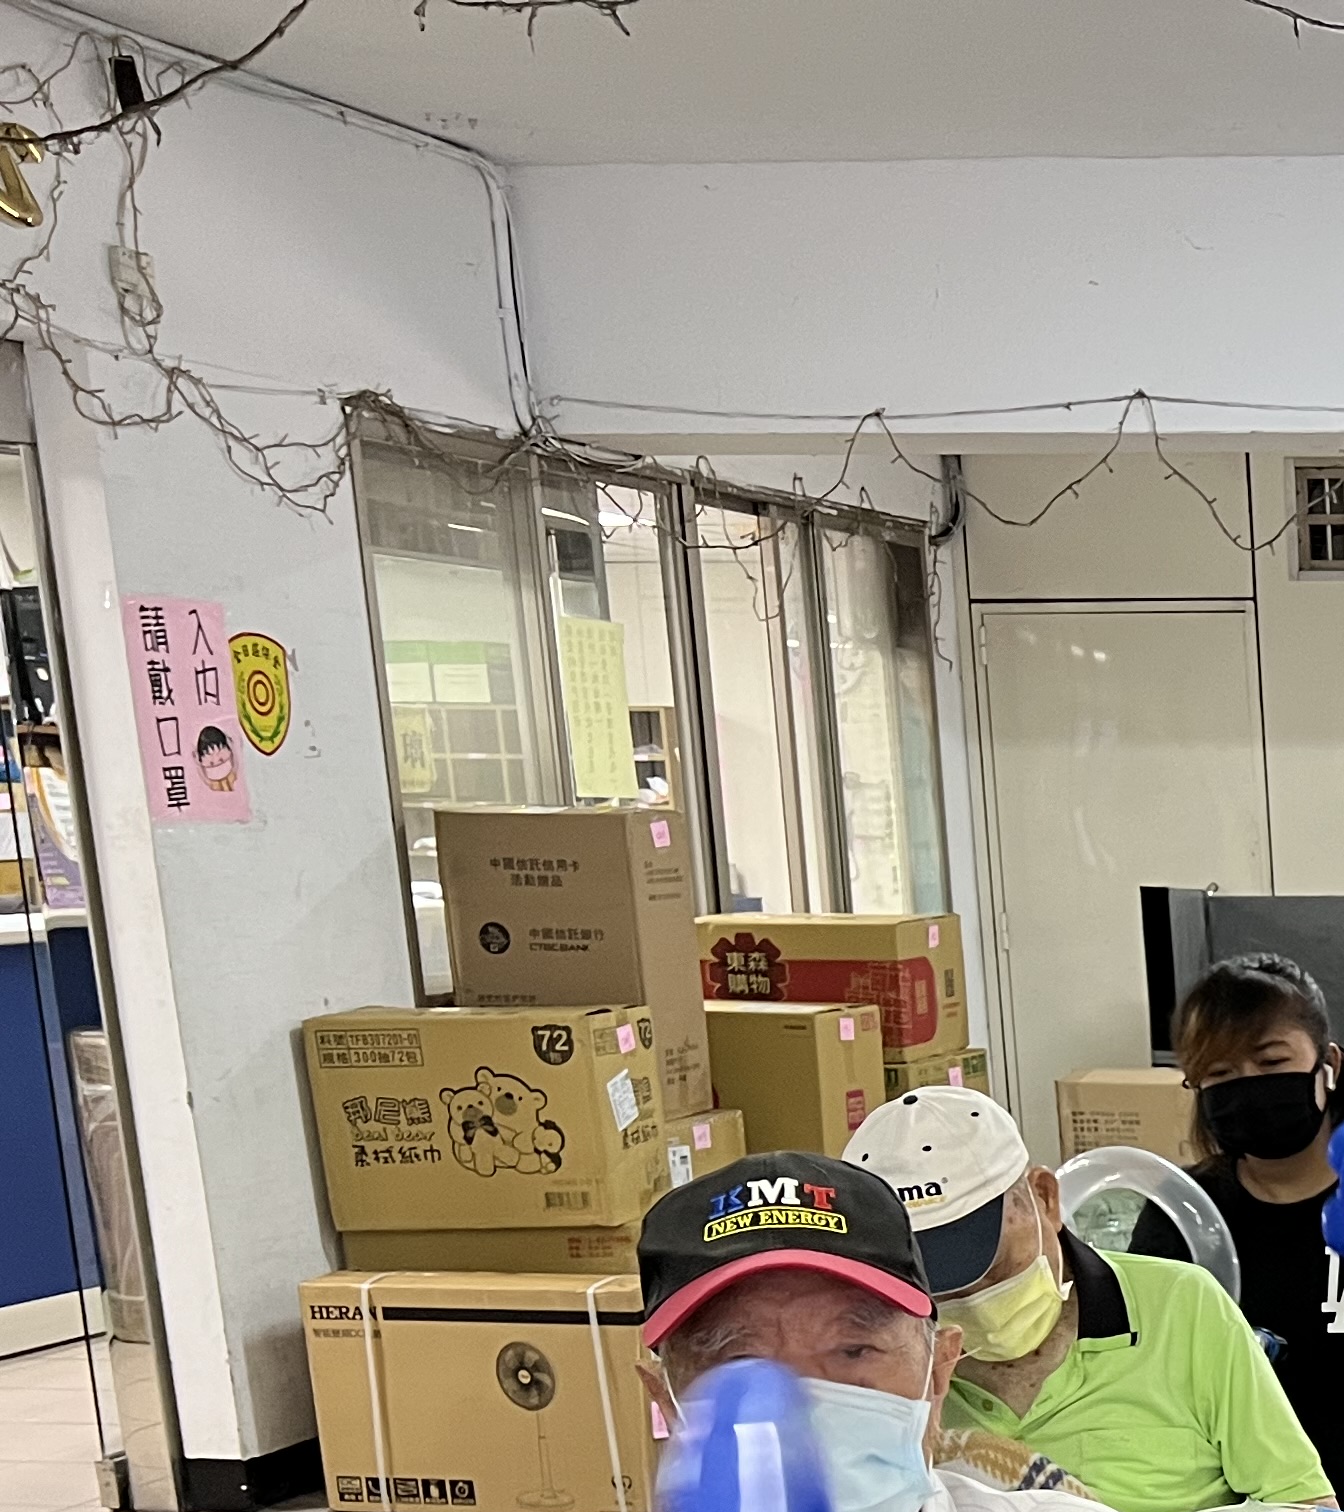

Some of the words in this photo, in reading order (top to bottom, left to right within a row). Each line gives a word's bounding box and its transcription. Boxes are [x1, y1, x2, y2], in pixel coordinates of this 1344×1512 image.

[138, 604, 191, 812] 請戴口罩
[725, 952, 769, 972] 東森
[727, 973, 771, 995] 購物
[537, 1030, 569, 1051] 72
[708, 1177, 836, 1219] KMT
[711, 1213, 754, 1237] NEW
[759, 1209, 840, 1229] ENERGY
[309, 1305, 378, 1321] HERAN
